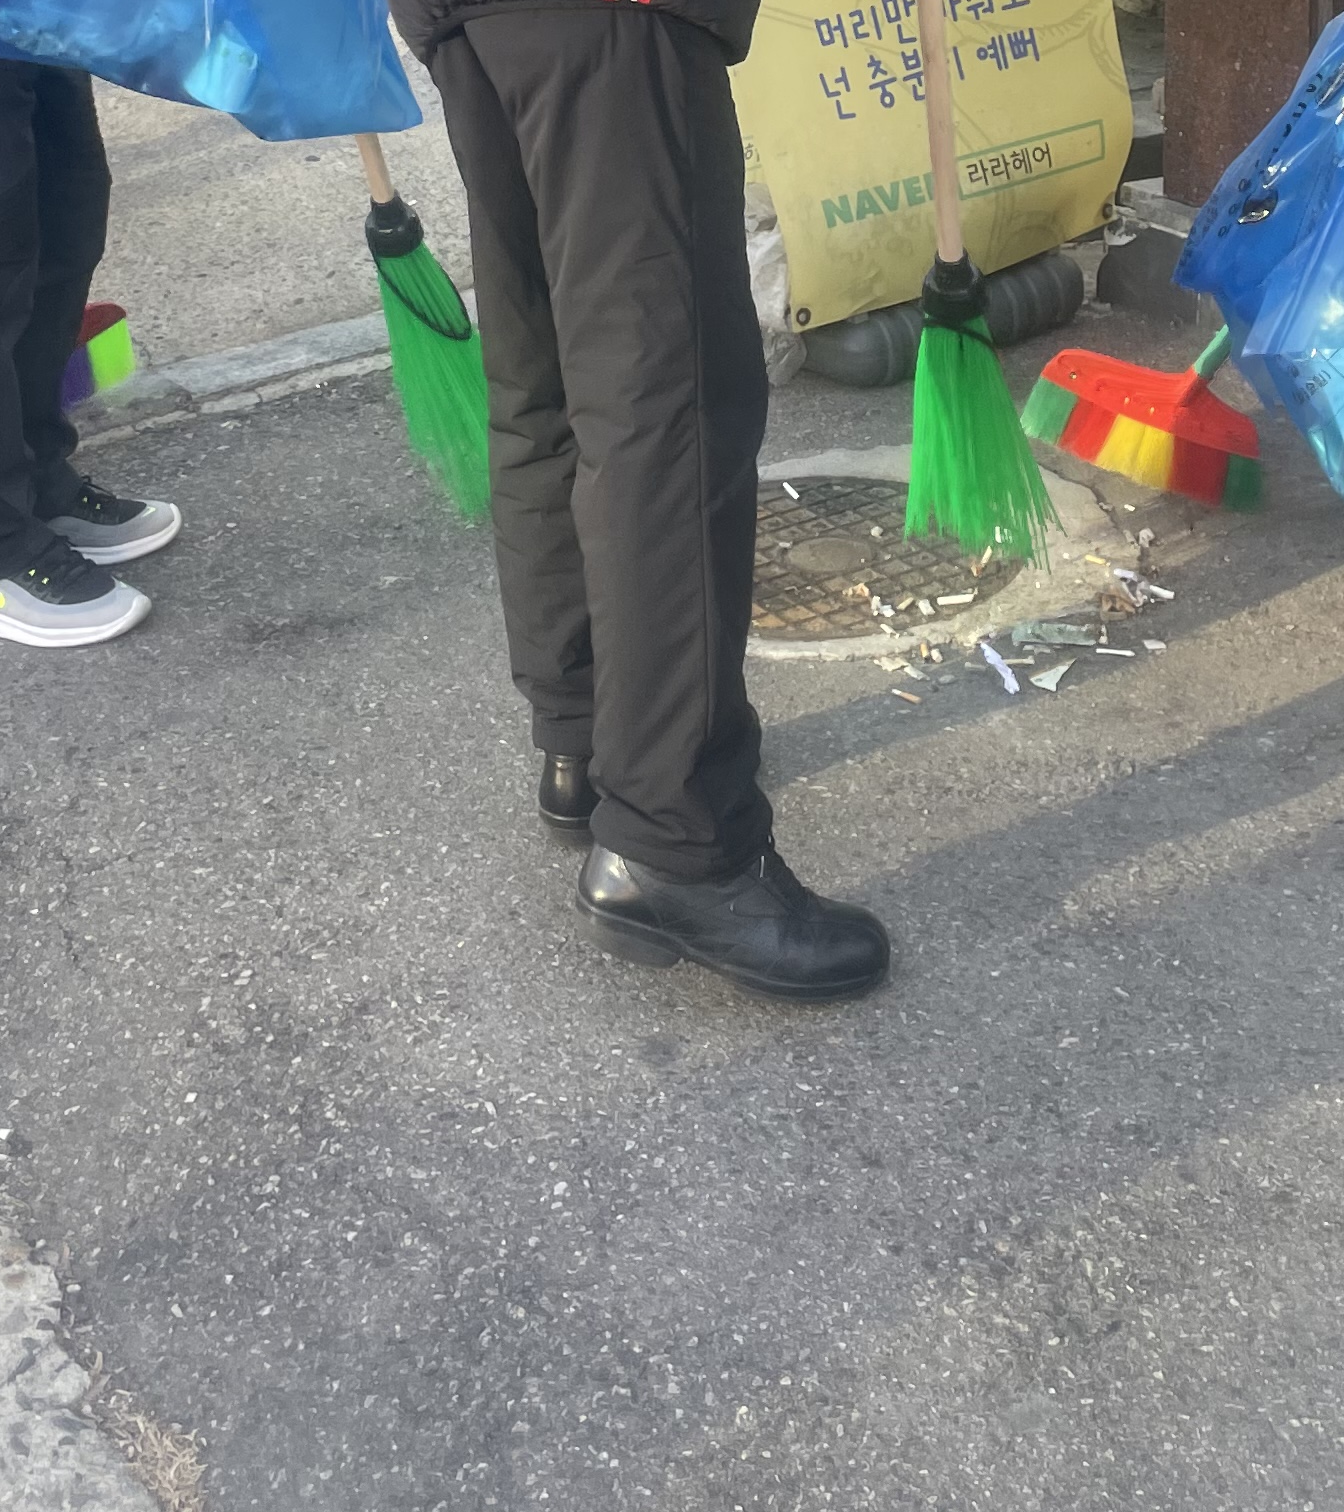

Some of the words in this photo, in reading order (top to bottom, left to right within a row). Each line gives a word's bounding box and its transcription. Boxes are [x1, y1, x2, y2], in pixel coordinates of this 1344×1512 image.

[820, 67, 856, 120] 넌
[976, 27, 1040, 71] 예뻐
[966, 142, 1054, 187] 라라헤어
